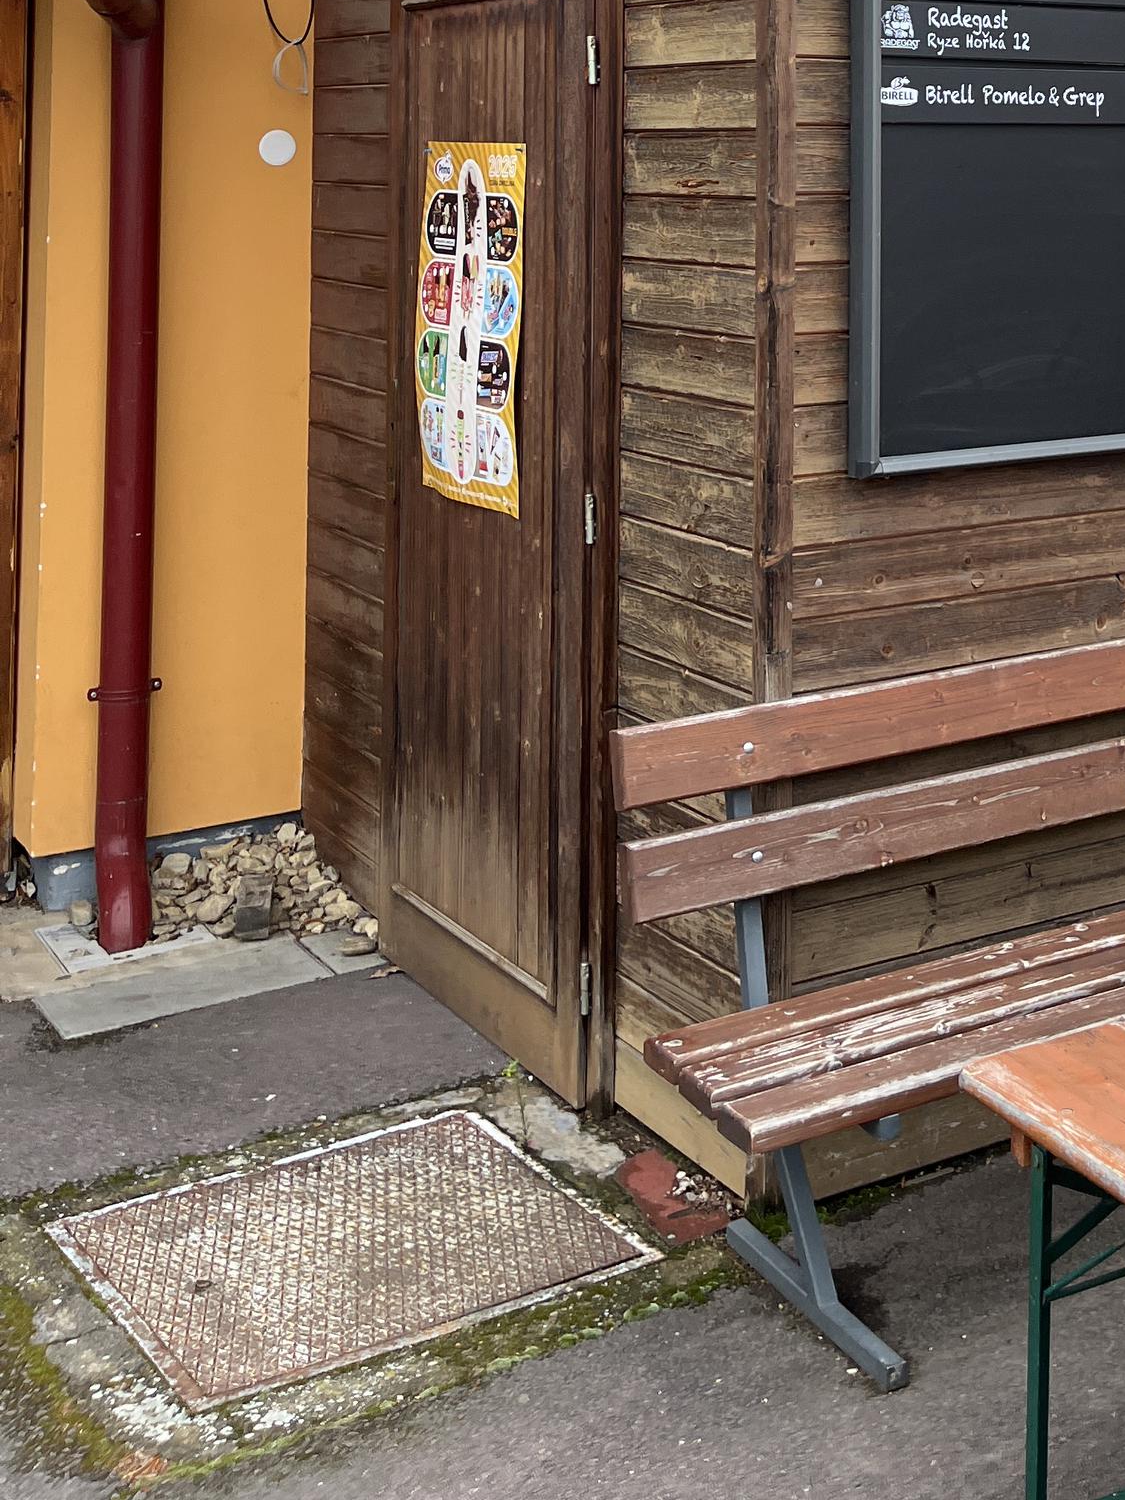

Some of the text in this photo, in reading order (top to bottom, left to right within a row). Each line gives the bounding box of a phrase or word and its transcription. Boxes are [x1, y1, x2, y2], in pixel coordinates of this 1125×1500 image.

[927, 5, 1009, 36] Radegast
[927, 31, 1031, 56] Ryze Hořká 12
[881, 91, 914, 101] BIRELL
[925, 83, 975, 105] Birell
[982, 85, 1044, 105] Pomelo
[1062, 87, 1105, 117] Grep
[487, 154, 518, 179] 2025
